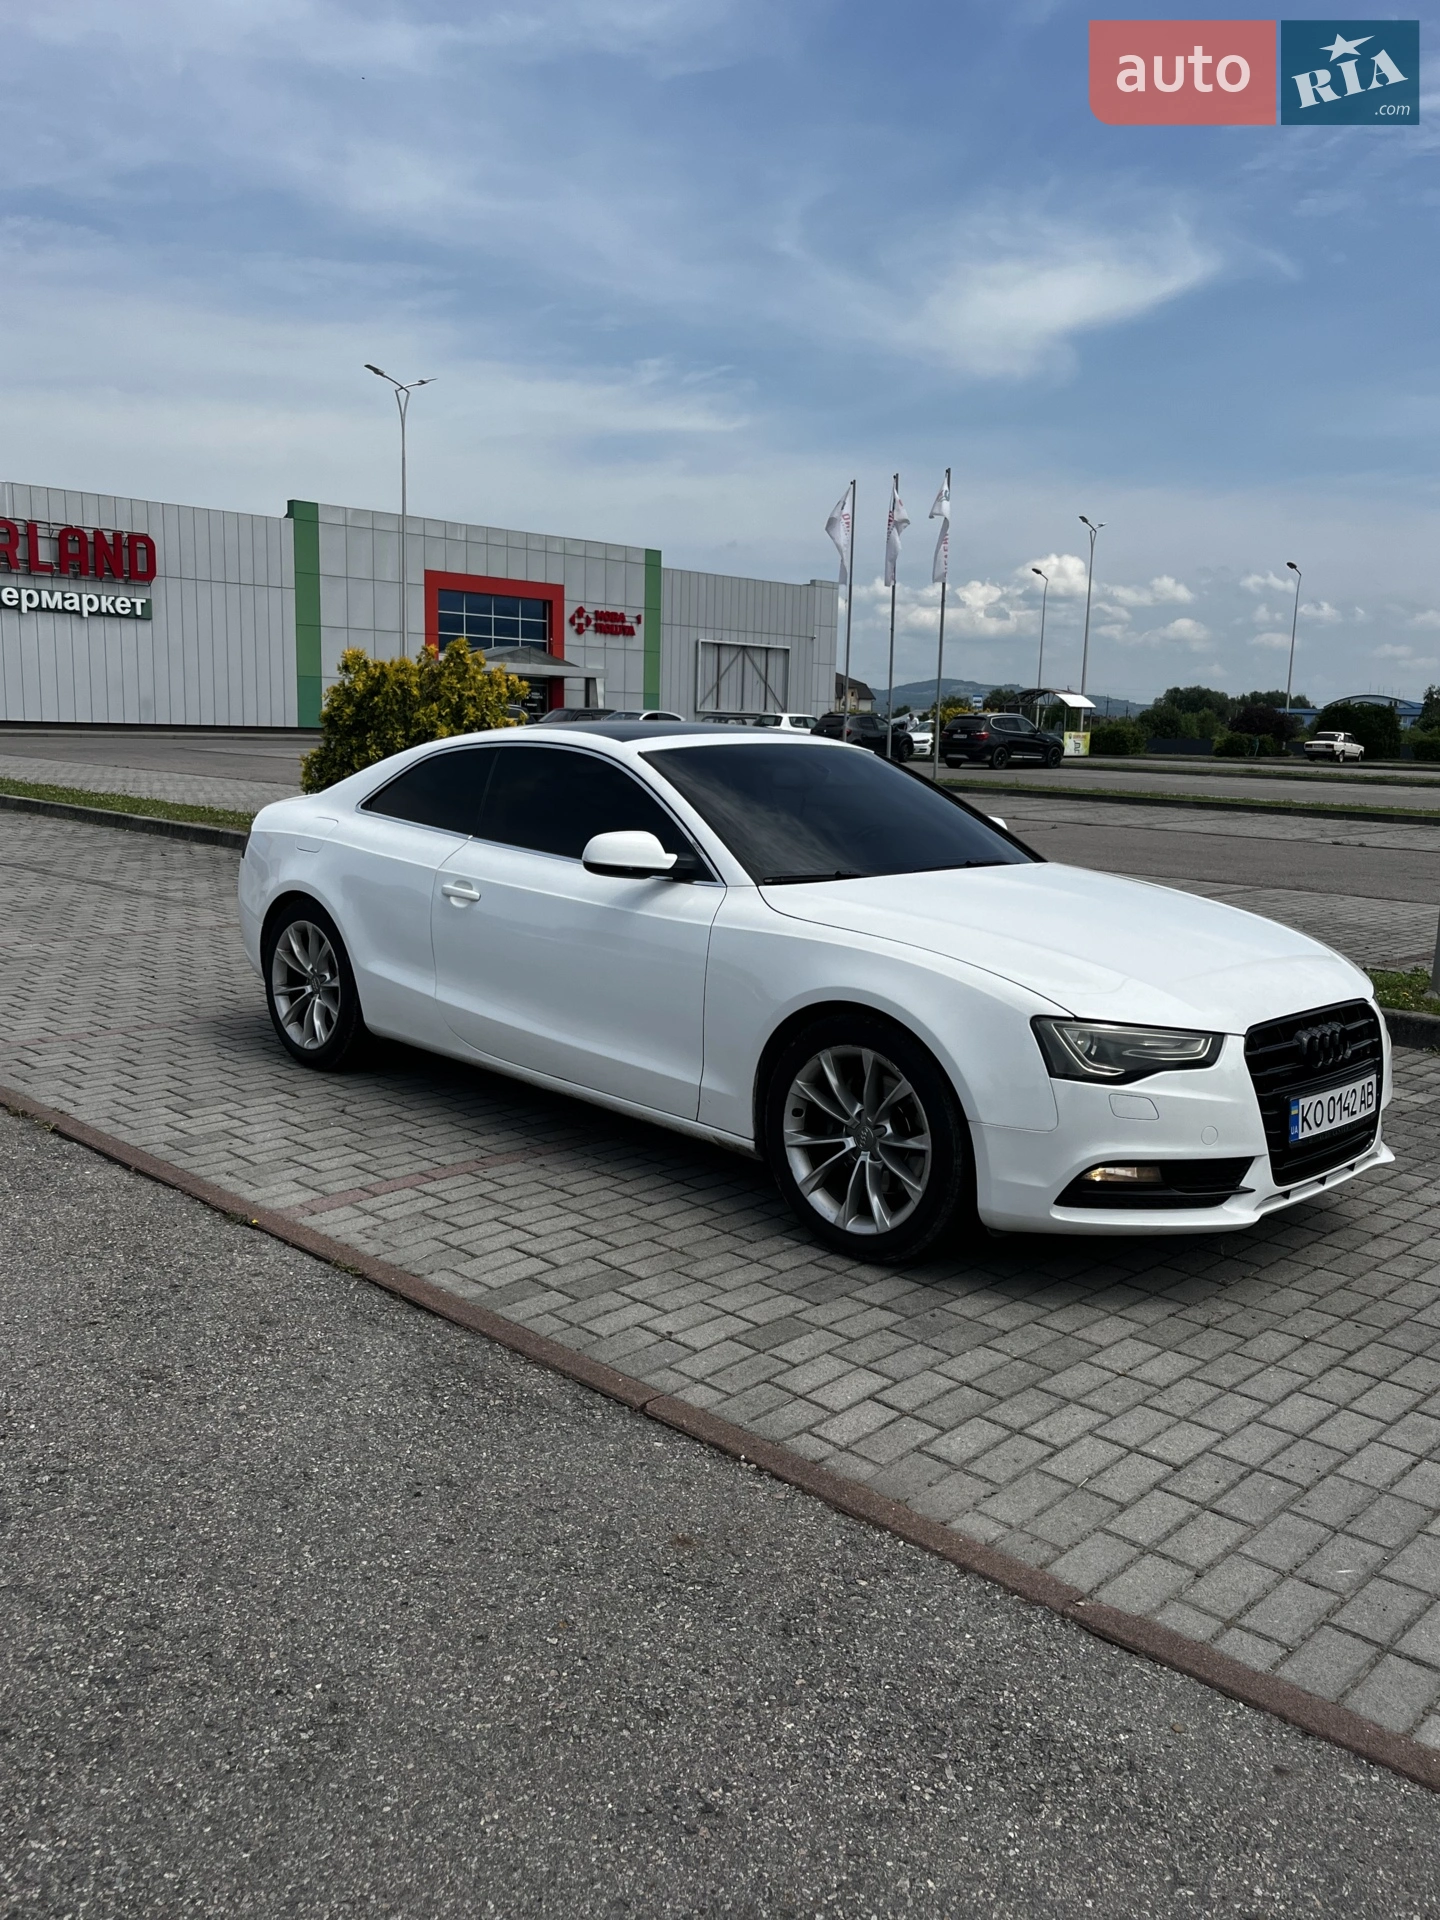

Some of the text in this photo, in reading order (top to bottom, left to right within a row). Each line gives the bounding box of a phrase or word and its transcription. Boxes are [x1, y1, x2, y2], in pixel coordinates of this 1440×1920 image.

[0, 586, 147, 617] ермаркет
[1327, 1088, 1357, 1124] 0142
[1290, 1126, 1299, 1136] UA
